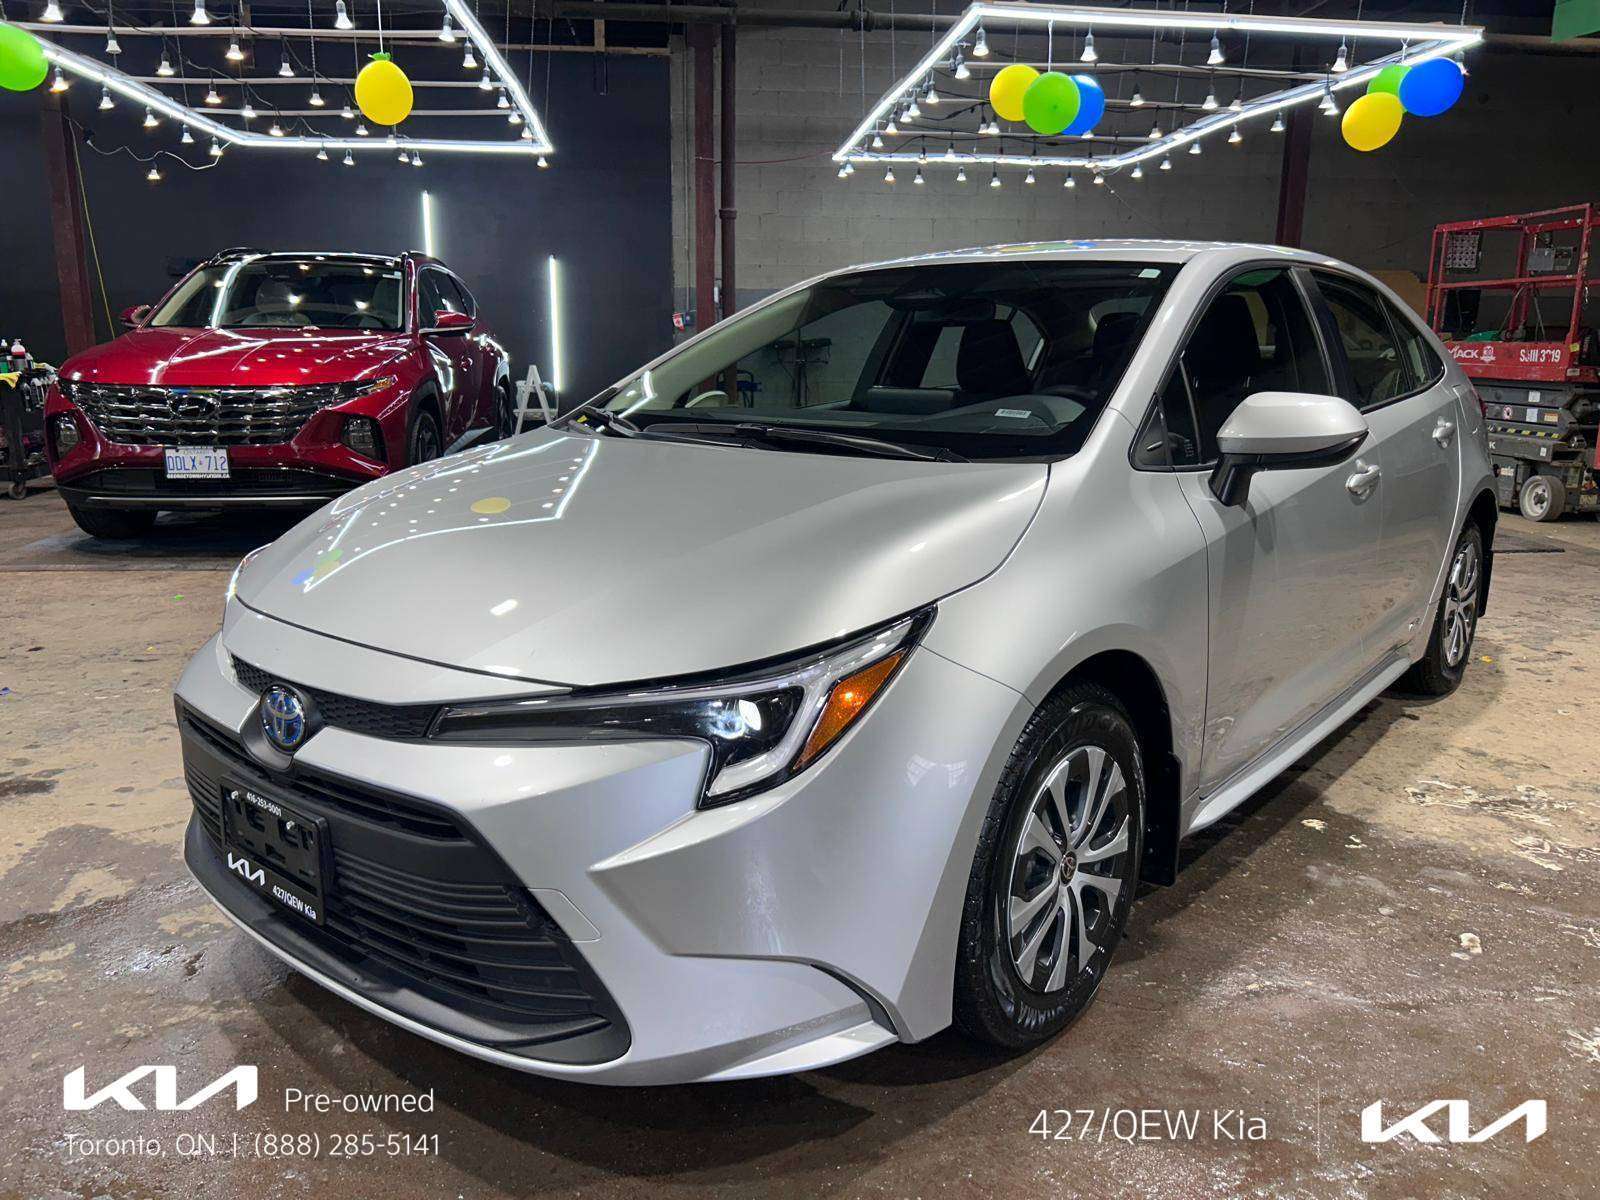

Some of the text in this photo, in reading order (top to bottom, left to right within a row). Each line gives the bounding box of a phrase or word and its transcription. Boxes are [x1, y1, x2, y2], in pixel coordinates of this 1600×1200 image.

[205, 455, 228, 470] 712
[272, 885, 317, 920] 427/QEW Kia
